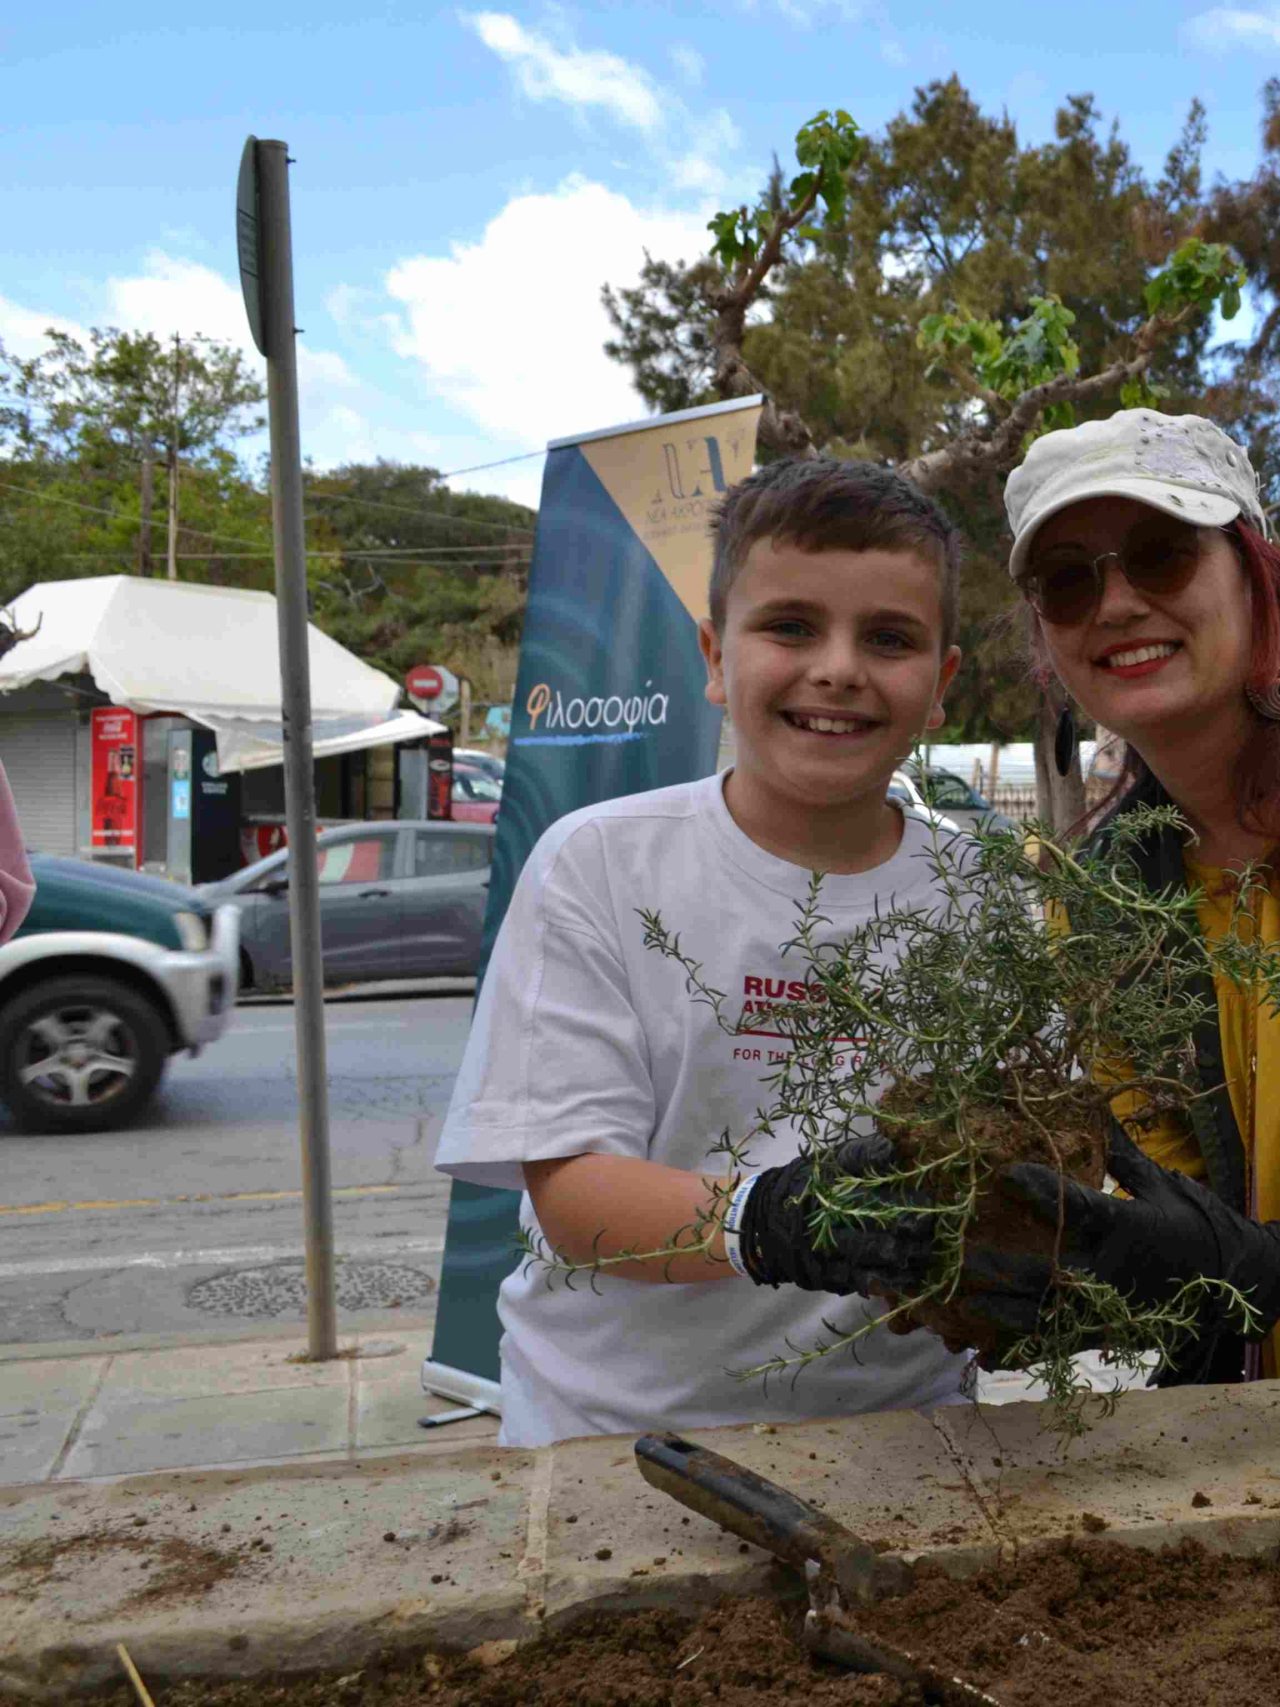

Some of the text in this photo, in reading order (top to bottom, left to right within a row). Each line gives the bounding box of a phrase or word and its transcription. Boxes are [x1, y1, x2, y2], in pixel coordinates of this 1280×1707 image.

[744, 975, 830, 1004] RUSS
[733, 1048, 761, 1061] FOR
[802, 1055, 845, 1067] LOG
